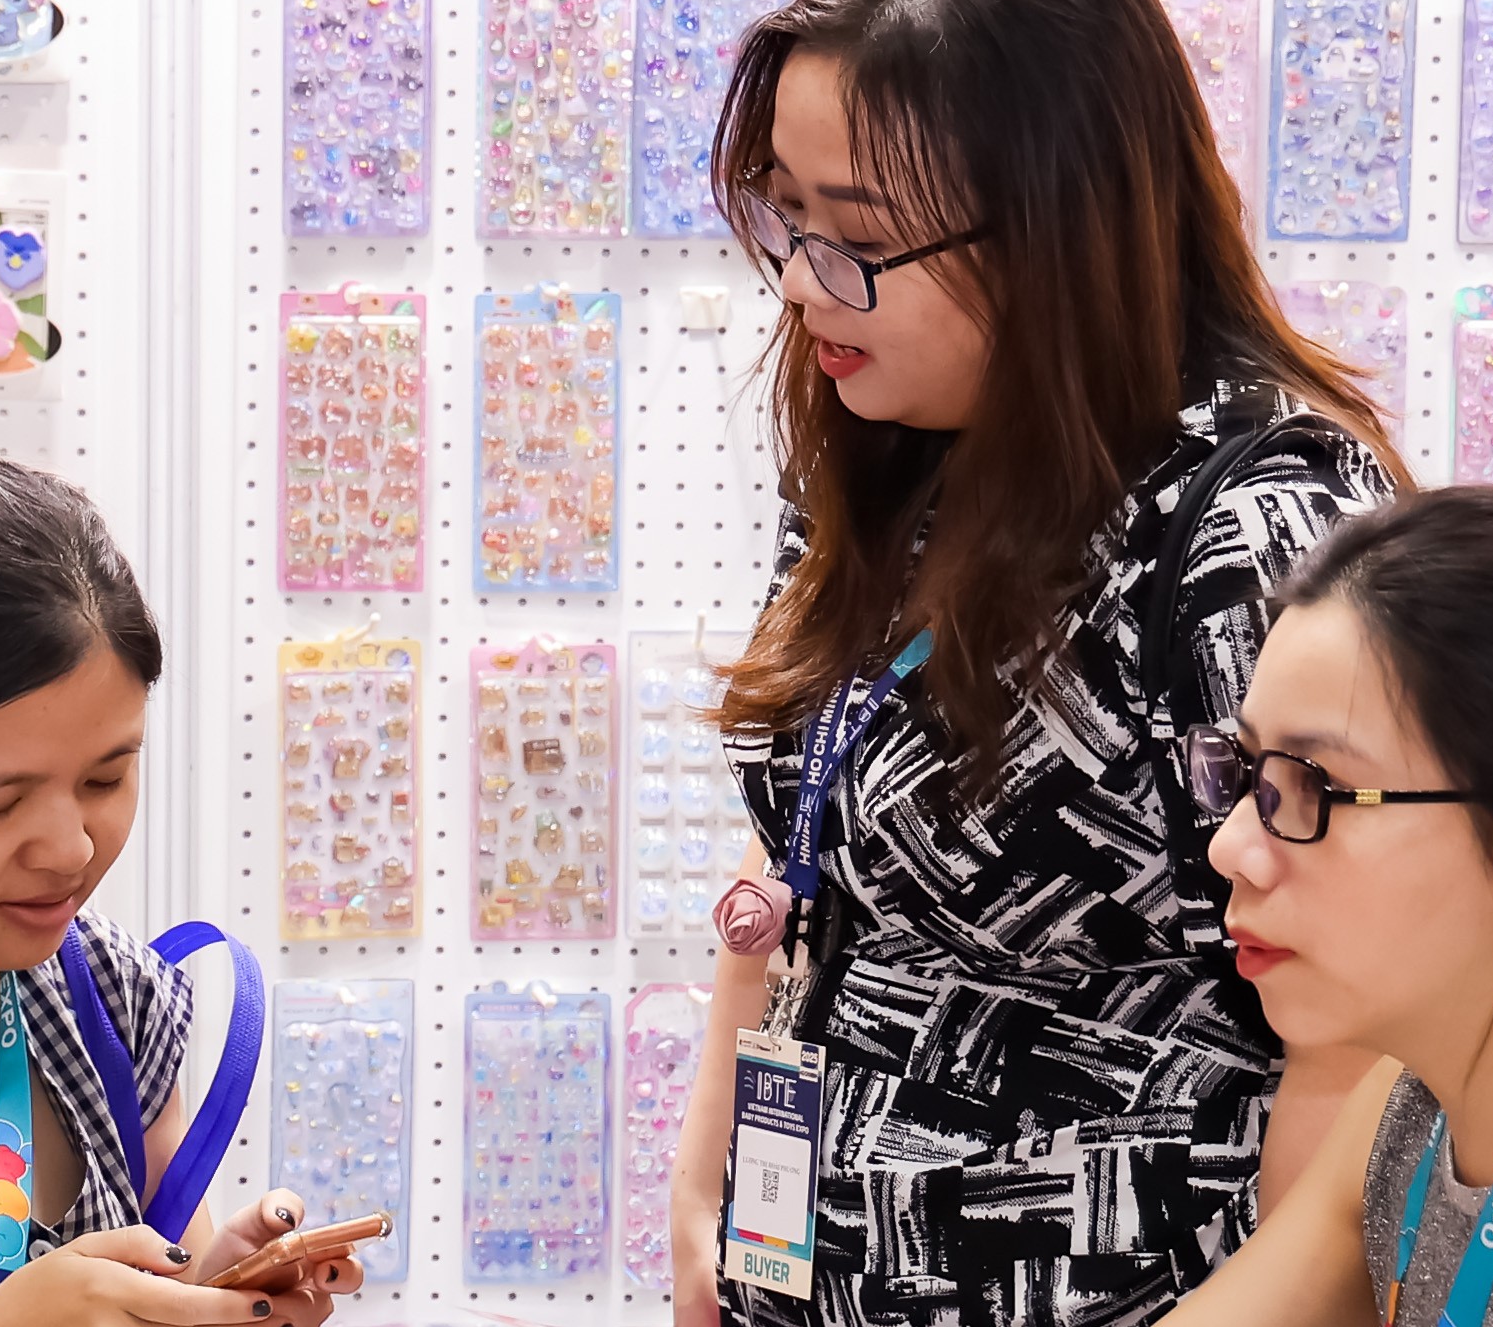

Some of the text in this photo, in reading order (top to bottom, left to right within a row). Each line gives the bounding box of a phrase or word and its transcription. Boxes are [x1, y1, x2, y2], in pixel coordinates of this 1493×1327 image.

[813, 725, 830, 755] CHI
[807, 755, 823, 786] HO
[0, 974, 18, 1049] EXPO
[800, 1050, 819, 1065] 2025
[756, 1070, 798, 1110] IBTE
[744, 1252, 791, 1285] BUYER
